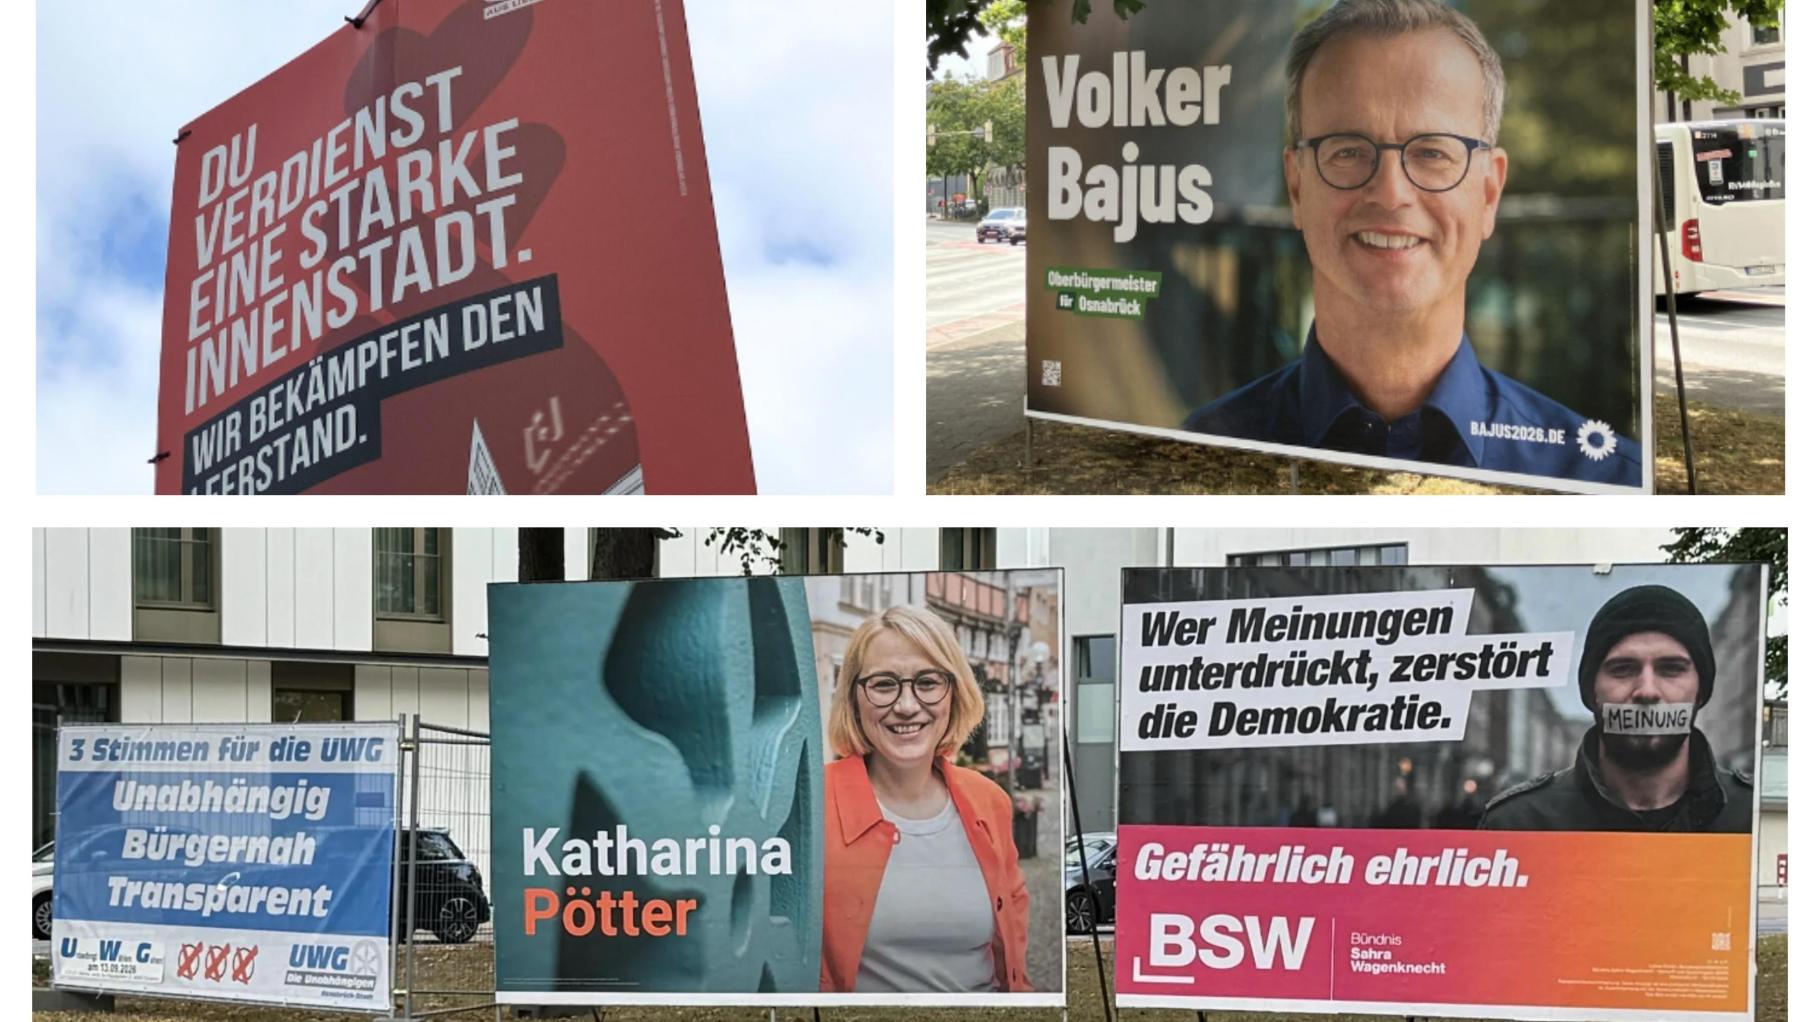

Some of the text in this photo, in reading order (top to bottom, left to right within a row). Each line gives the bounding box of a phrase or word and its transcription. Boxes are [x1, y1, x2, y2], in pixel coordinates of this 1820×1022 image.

[1041, 50, 1232, 128] Volker
[194, 66, 463, 270] VERDIENST
[198, 123, 258, 209] DU
[1048, 141, 1214, 243] Bajus
[188, 117, 523, 342] EINE STARKE
[184, 194, 534, 416] INNENSTADT.
[1047, 270, 1157, 294] Oberbürgermeister
[1060, 294, 1141, 316] für Osnabrück
[192, 409, 242, 477] WIR
[249, 313, 451, 443] BEKÄMPFEN
[461, 286, 546, 352] DEN
[190, 403, 368, 496] EERSTAND.
[1470, 420, 1566, 446] BAJUS2026.DE
[1140, 600, 1454, 647] Wer Meinungen
[1139, 641, 1554, 693] unterdrückt, zerstört
[1138, 695, 1451, 740] die Demokratie.
[1607, 709, 1689, 730] MEINUNG
[69, 736, 384, 762] 3 Stimmen für die UWG
[112, 778, 330, 820] Unabhängig
[121, 826, 316, 866] Bürgernah
[522, 825, 792, 876] Katharina
[1134, 842, 1529, 889] Gefährlich ehrlich.
[108, 876, 333, 917] Transparent
[523, 886, 697, 936] Pötter
[289, 944, 349, 970] UWG
[1149, 913, 1316, 971] BSW
[1350, 932, 1402, 946] Bündnis
[1350, 947, 1392, 961] Sahra
[1350, 960, 1446, 975] Wagenknecht
